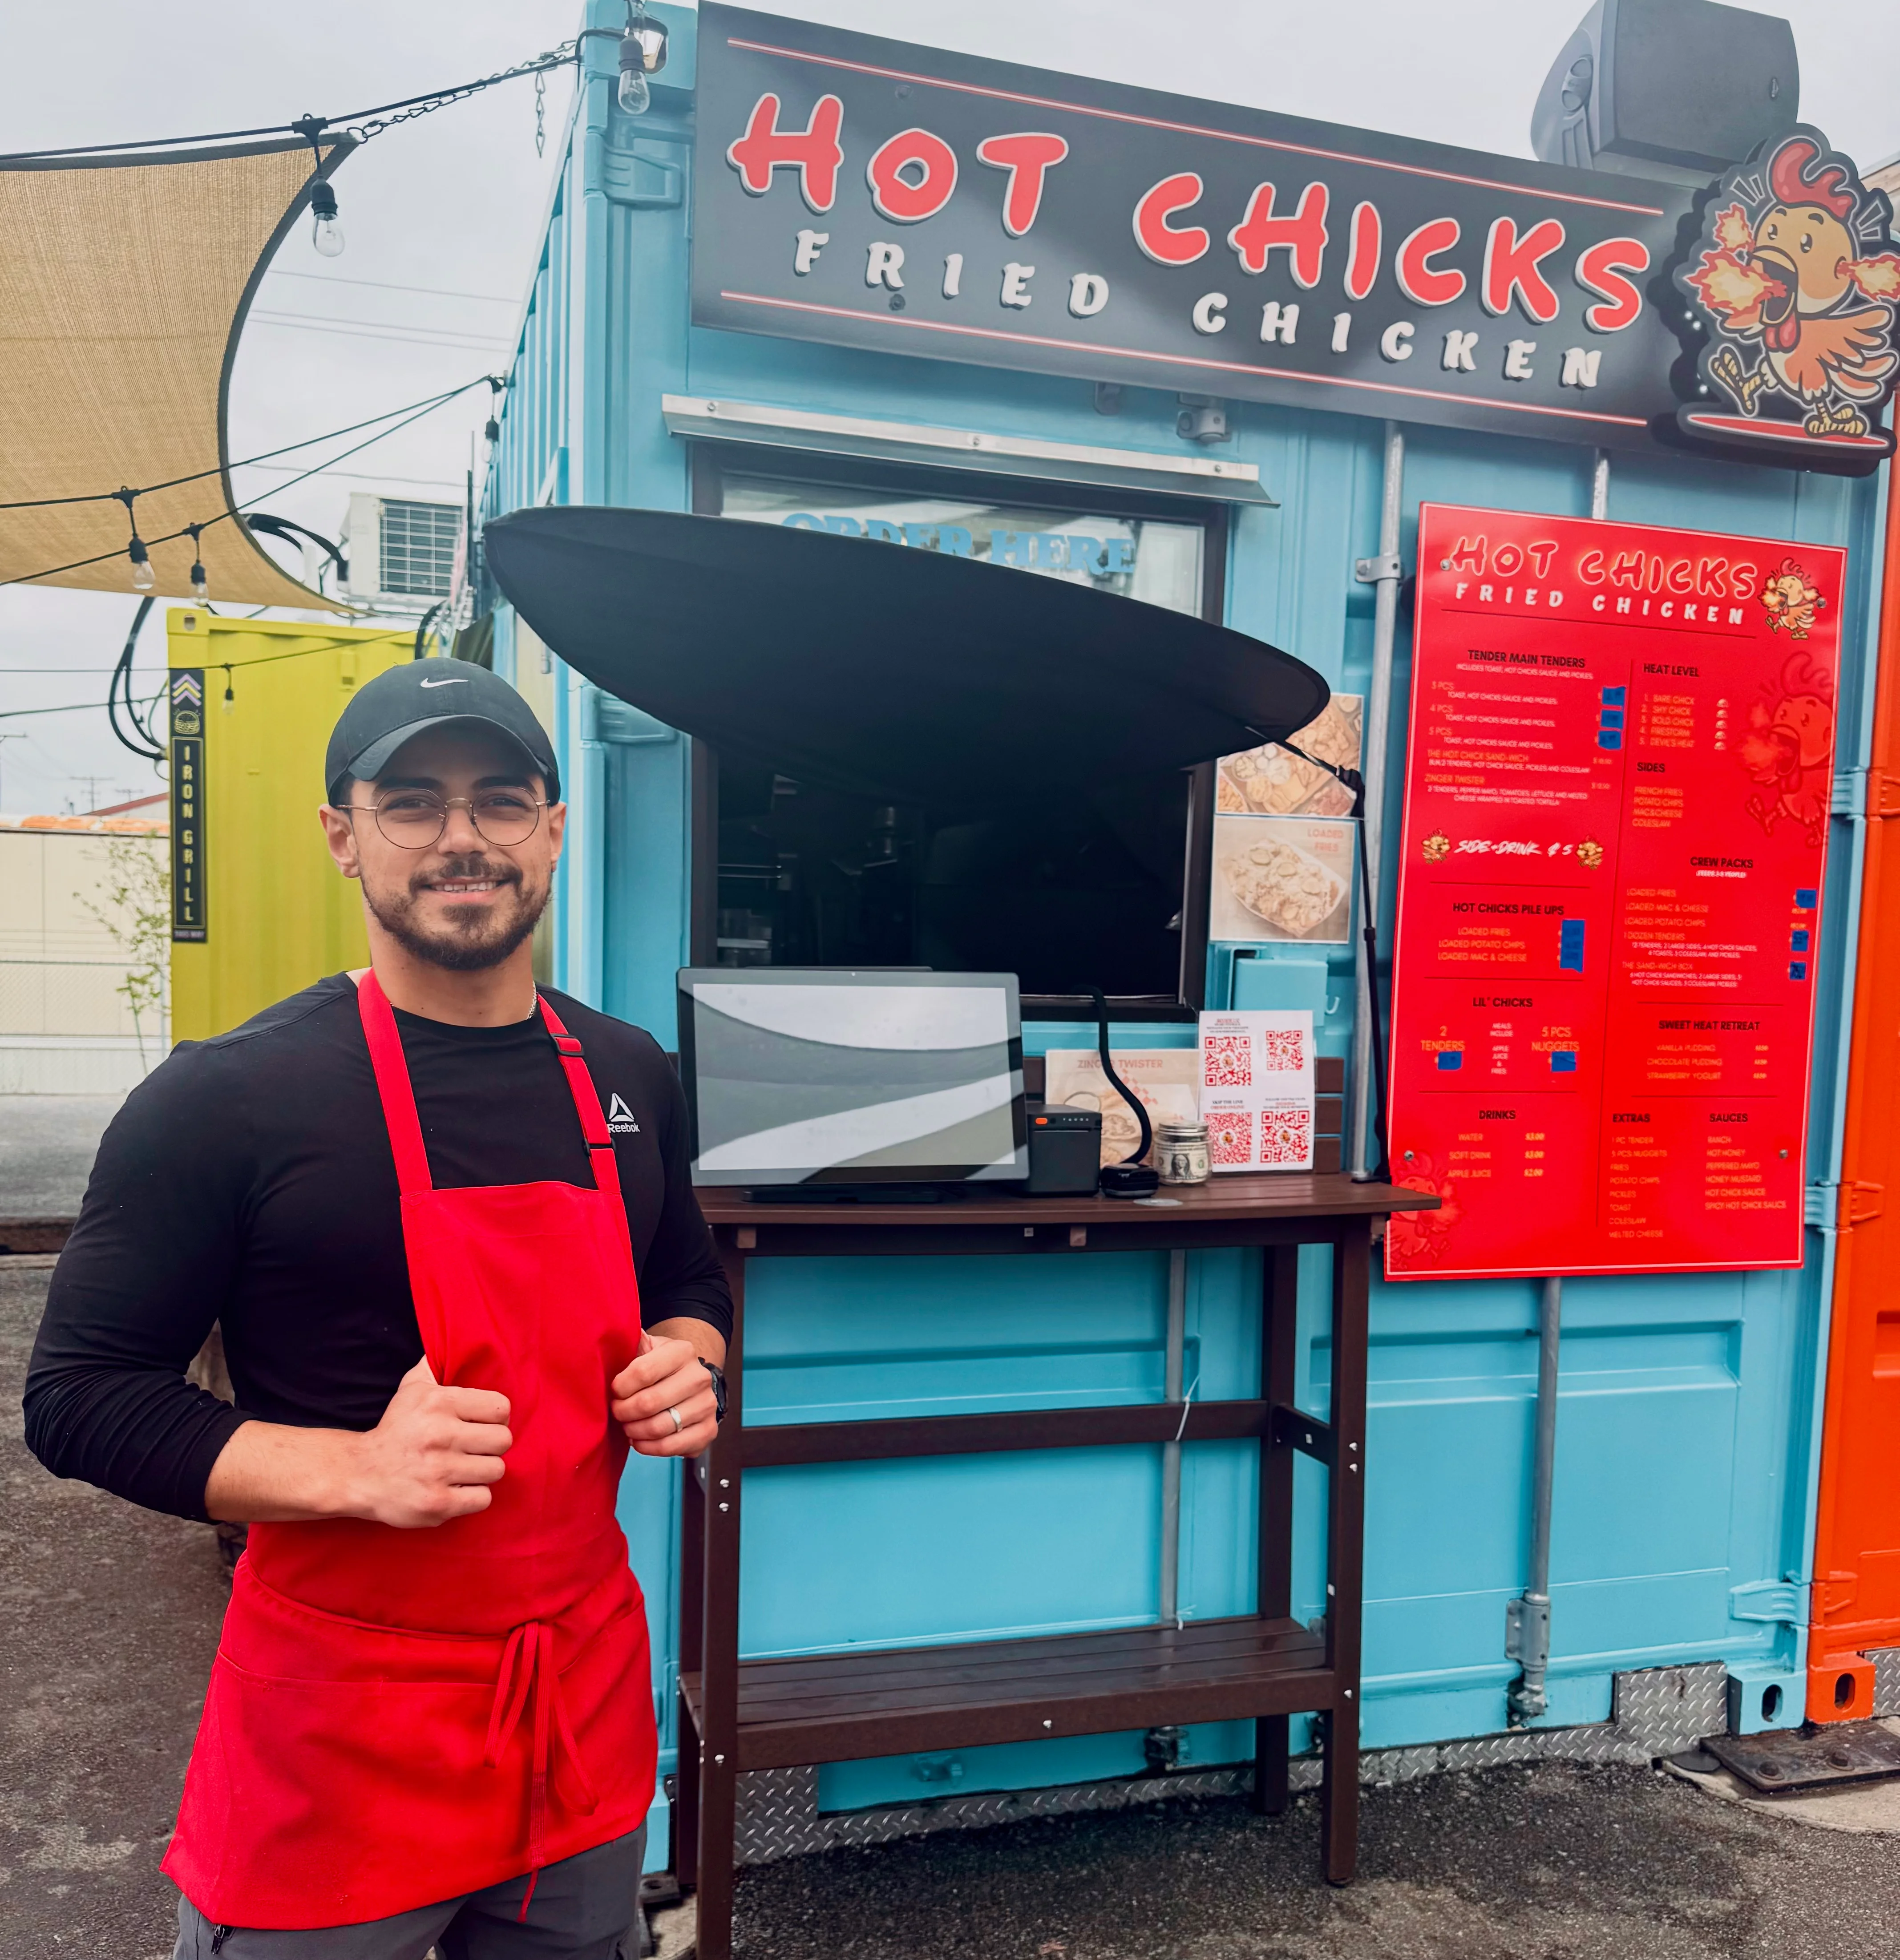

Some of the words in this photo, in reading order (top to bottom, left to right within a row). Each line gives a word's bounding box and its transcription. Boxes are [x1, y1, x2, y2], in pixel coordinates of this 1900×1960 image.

[726, 92, 1069, 236] HOT
[1132, 171, 1652, 333] CHICKS
[795, 228, 1111, 318] FRIED
[1192, 289, 1606, 392] CHICKEN
[990, 529, 1135, 574] HERE
[1450, 534, 1559, 578] HOT
[1578, 550, 1759, 600] CHICKS
[1455, 582, 1564, 608] FRIED
[1592, 594, 1744, 625] CHICKEN
[1467, 650, 1506, 662] TENDER
[1509, 653, 1538, 665] MAIN
[1540, 655, 1585, 668] TENDERS
[1643, 663, 1670, 675] HEAT
[1671, 665, 1699, 677] LEVEL
[1437, 681, 1454, 690] PCS
[1653, 694, 1671, 703] BARE
[1672, 695, 1694, 705] CHICK
[1437, 704, 1453, 712] PCS
[1652, 705, 1667, 714] SHY
[1669, 707, 1691, 715] CHICK
[1652, 716, 1670, 725] BOLD
[1672, 717, 1694, 727] CHICK
[1435, 727, 1452, 736] PCS
[1651, 727, 1690, 737] FIRESTORM
[1427, 749, 1440, 758] THE
[1442, 750, 1459, 759] HOT
[1460, 751, 1484, 760] CHICK
[1637, 762, 1666, 773] SIDES
[182, 745, 193, 819] IRON
[1425, 773, 1452, 783] ZINGER
[1455, 775, 1485, 785] TWISTER
[1634, 786, 1660, 795] FRENCH
[1661, 788, 1683, 796] FRIES
[1634, 797, 1660, 806] POTATO
[1661, 798, 1683, 807] CHIPS
[1632, 819, 1671, 828] COLESLAW
[1307, 828, 1344, 839] LOADED
[1314, 842, 1338, 852] FRIES
[1690, 857, 1718, 867] CREW
[1720, 858, 1753, 868] PACKS
[182, 828, 194, 921] GRILL
[1627, 888, 1655, 897] LOADED
[1657, 889, 1676, 897] FRIES
[1453, 903, 1474, 913] HOT
[1478, 903, 1519, 914] CHICKS
[1521, 905, 1541, 915] PILE
[1544, 906, 1564, 915] UPS
[1625, 902, 1654, 911] LOADED
[1656, 904, 1673, 912] MAC
[1681, 904, 1709, 913] CHEESE
[1625, 917, 1653, 925] LOADED
[1655, 918, 1684, 926] POTATO
[1684, 919, 1706, 927] CHIPS
[1458, 928, 1488, 936] LOADED
[1490, 928, 1511, 936] FRIES
[1627, 931, 1654, 940] DOZEN
[1655, 932, 1686, 941] TENDERS
[1439, 940, 1469, 948] LOADED
[1471, 940, 1501, 949] POTATO
[1503, 941, 1526, 950] CHIPS
[1438, 952, 1468, 960] LOADED
[1470, 953, 1488, 961] MAC
[1497, 953, 1527, 962] CHEESE
[1492, 998, 1533, 1008] CHICKS
[1440, 1026, 1447, 1036] 2
[1658, 1021, 1691, 1030] SWEET
[1693, 1021, 1718, 1030] HEAT
[1720, 1022, 1760, 1031] RETREAT
[1541, 1026, 1548, 1037] 5
[1550, 1026, 1572, 1038] PCS
[1421, 1040, 1466, 1051] TENDERS
[1531, 1041, 1580, 1052] NUGGETS
[1077, 1059, 1115, 1068] ZINGR
[1118, 1059, 1163, 1069] TWISTER
[1647, 1058, 1690, 1066] CHOCOLATE
[1479, 1110, 1516, 1120] DRINKS
[1613, 1114, 1650, 1123] EXTRAS
[1709, 1113, 1748, 1123] SAUCES
[607, 1123, 640, 1133] Reebok
[1449, 1152, 1469, 1160] SOFT
[1470, 1152, 1491, 1160] DRINK
[1722, 1149, 1746, 1157] HONEY
[1447, 1170, 1469, 1178] APPLE
[1470, 1170, 1491, 1178] JUICE
[1706, 1175, 1729, 1183] HONEY
[1730, 1175, 1762, 1183] MUSTARD
[1609, 1190, 1637, 1198] PICKLES
[1705, 1188, 1719, 1196] HOT
[1720, 1188, 1741, 1196] CHICK
[1742, 1188, 1766, 1196] SAUCE
[1610, 1203, 1631, 1211] TOAST
[1705, 1202, 1725, 1210] SPICY
[1741, 1201, 1762, 1209] CHICK
[1763, 1201, 1787, 1209] SAUCE
[1609, 1230, 1634, 1238] MELTED
